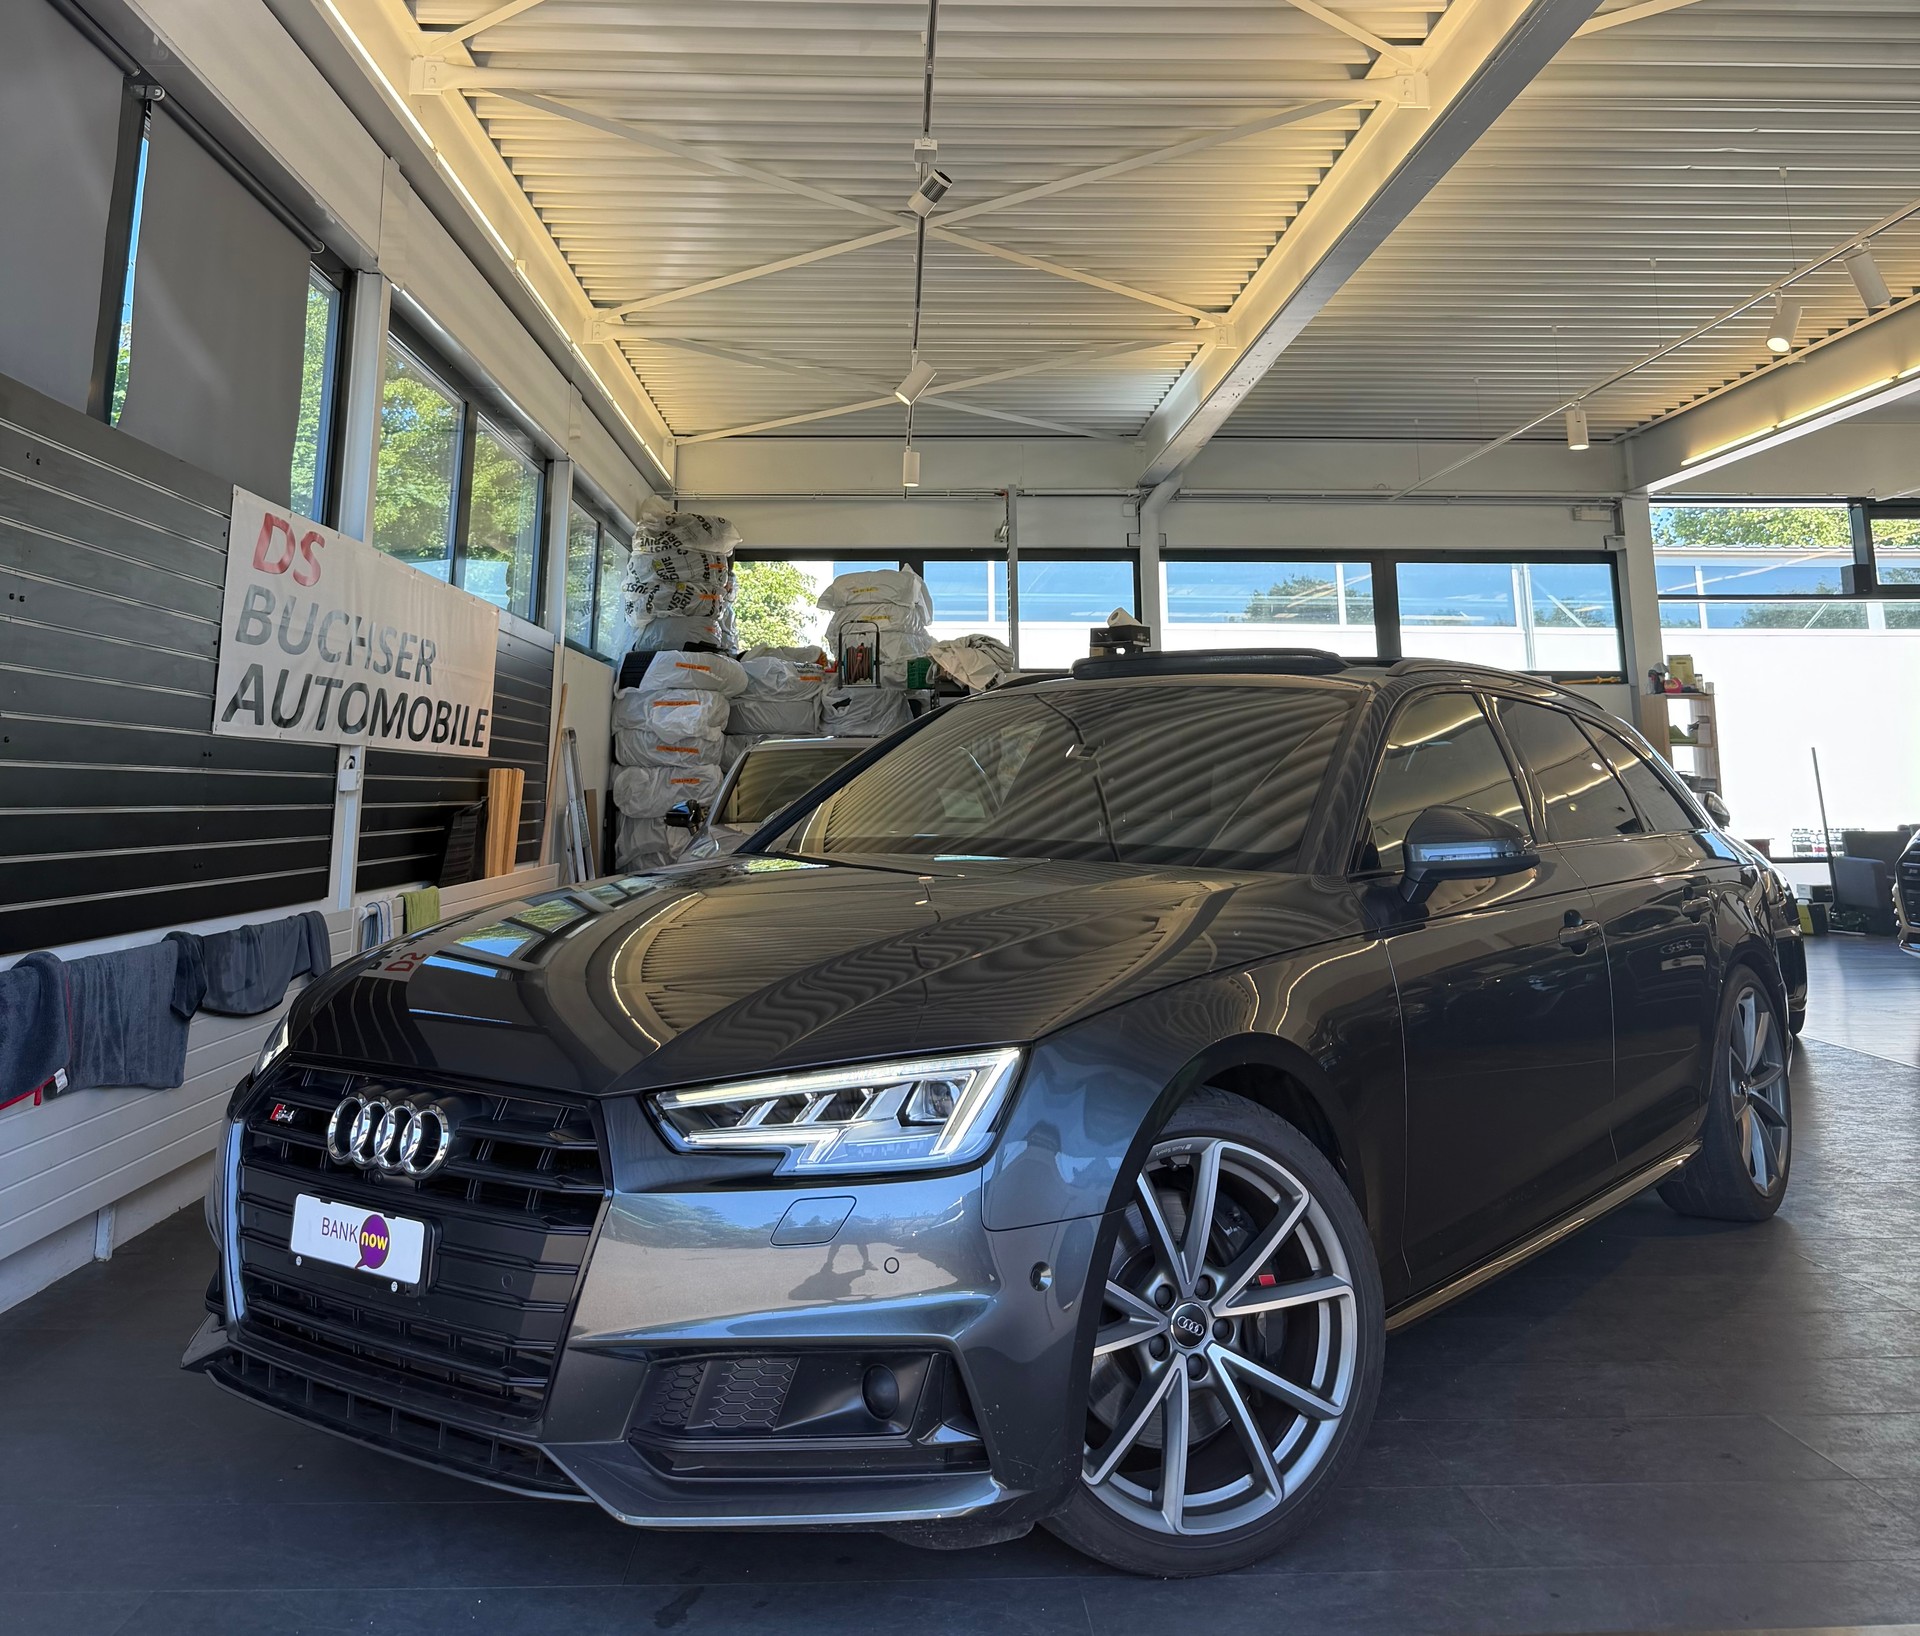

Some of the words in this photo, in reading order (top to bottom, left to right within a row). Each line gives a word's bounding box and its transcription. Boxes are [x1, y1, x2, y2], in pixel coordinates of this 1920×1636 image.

[252, 512, 325, 587] DS
[235, 584, 436, 685] BUCHSER
[221, 663, 489, 748] AUTOMOBILE
[321, 1216, 359, 1244] BANK
[360, 1230, 389, 1251] now
